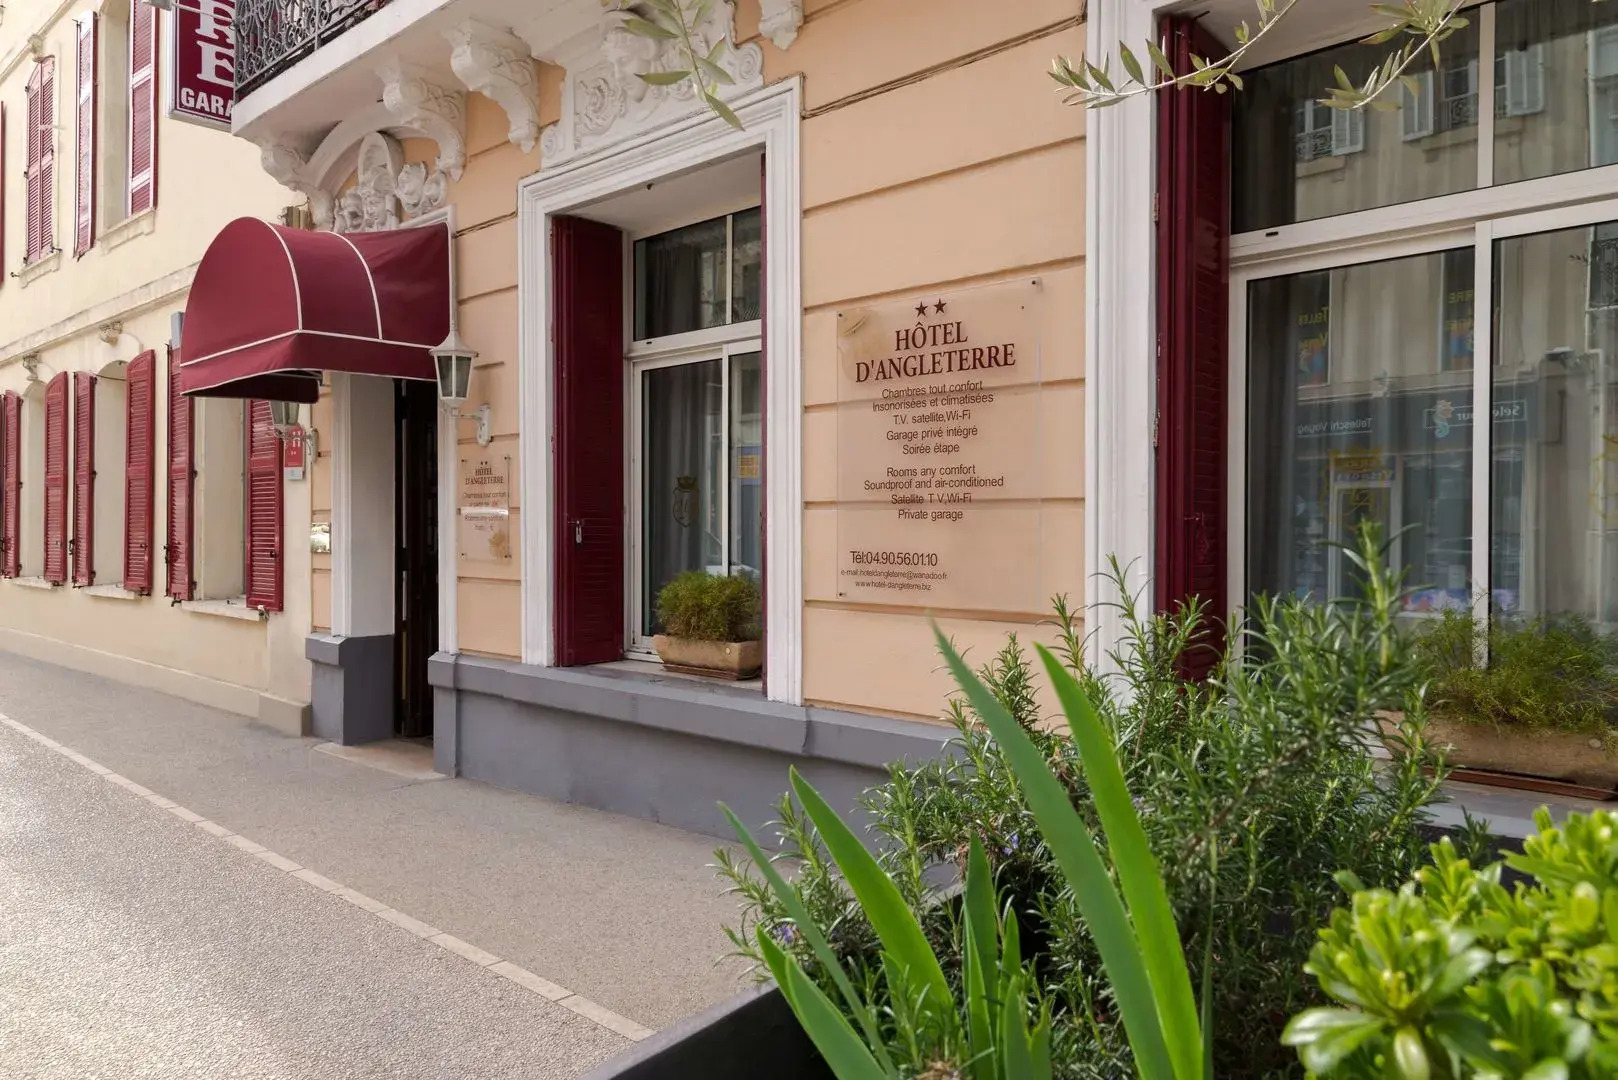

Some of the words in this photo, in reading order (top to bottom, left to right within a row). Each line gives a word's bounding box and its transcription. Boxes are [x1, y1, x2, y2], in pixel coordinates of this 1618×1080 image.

[895, 321, 968, 351] HÔTEL
[855, 343, 1016, 382] D'ANGLETERRE
[882, 385, 926, 399] Chambres
[929, 384, 946, 394] tout
[950, 381, 983, 392] confort
[873, 398, 927, 411] Insonorisées
[930, 398, 938, 407] et
[941, 394, 994, 406] climatisées
[886, 430, 918, 441] Garage
[921, 428, 943, 441] privé
[946, 425, 978, 439] intégré
[902, 444, 931, 454] Soirée
[934, 443, 960, 455] étape
[887, 467, 917, 477] Rooms
[921, 468, 937, 478] any
[939, 464, 976, 475] comfort
[864, 478, 912, 491] Soundproof
[916, 478, 932, 488] and
[935, 476, 1004, 488] air-conditioned
[891, 494, 924, 505] Satellite
[898, 509, 928, 519] Private
[931, 510, 963, 521] garage
